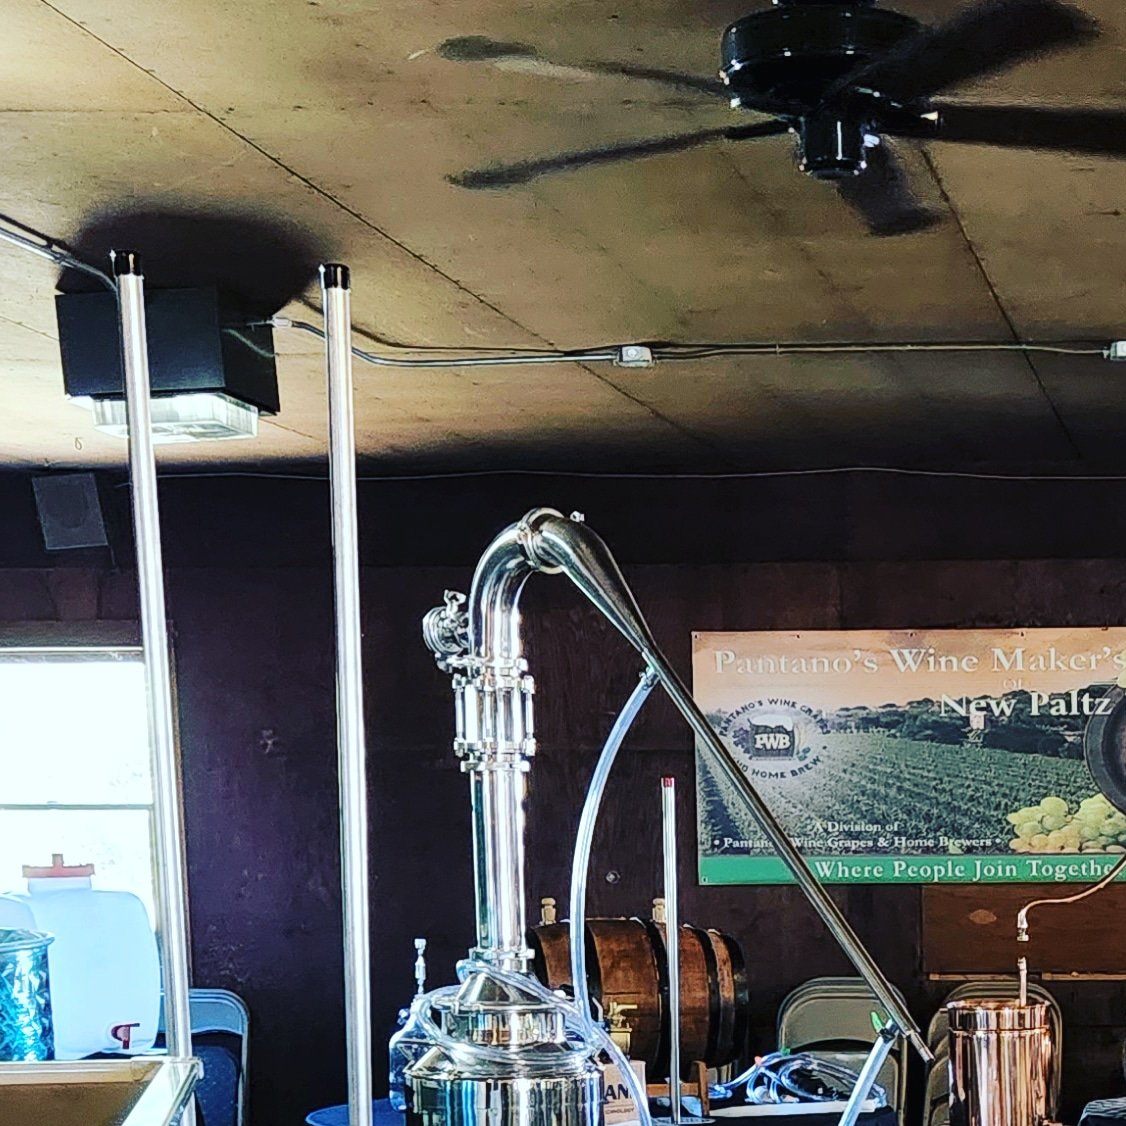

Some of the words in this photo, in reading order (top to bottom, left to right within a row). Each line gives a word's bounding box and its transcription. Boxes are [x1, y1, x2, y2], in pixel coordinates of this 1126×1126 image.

[714, 649, 879, 674] Pantano's
[888, 647, 979, 674] Wine
[991, 647, 1126, 673] Maker's
[767, 698, 798, 709] WINE
[940, 694, 1017, 717] New
[1029, 690, 1114, 717] Paltz
[754, 732, 791, 750] PWB
[751, 767, 787, 780] HOME
[790, 755, 822, 778] BREW
[828, 821, 882, 832] Division
[885, 820, 900, 832] of
[789, 837, 825, 848] Wine
[827, 837, 874, 851] Grapes
[877, 836, 890, 847] &
[893, 836, 936, 847] Home
[939, 836, 993, 848] Brewers
[815, 860, 884, 878] Where
[893, 860, 966, 883] People
[972, 860, 1017, 882] Join
[1026, 859, 1122, 882] Togethe
